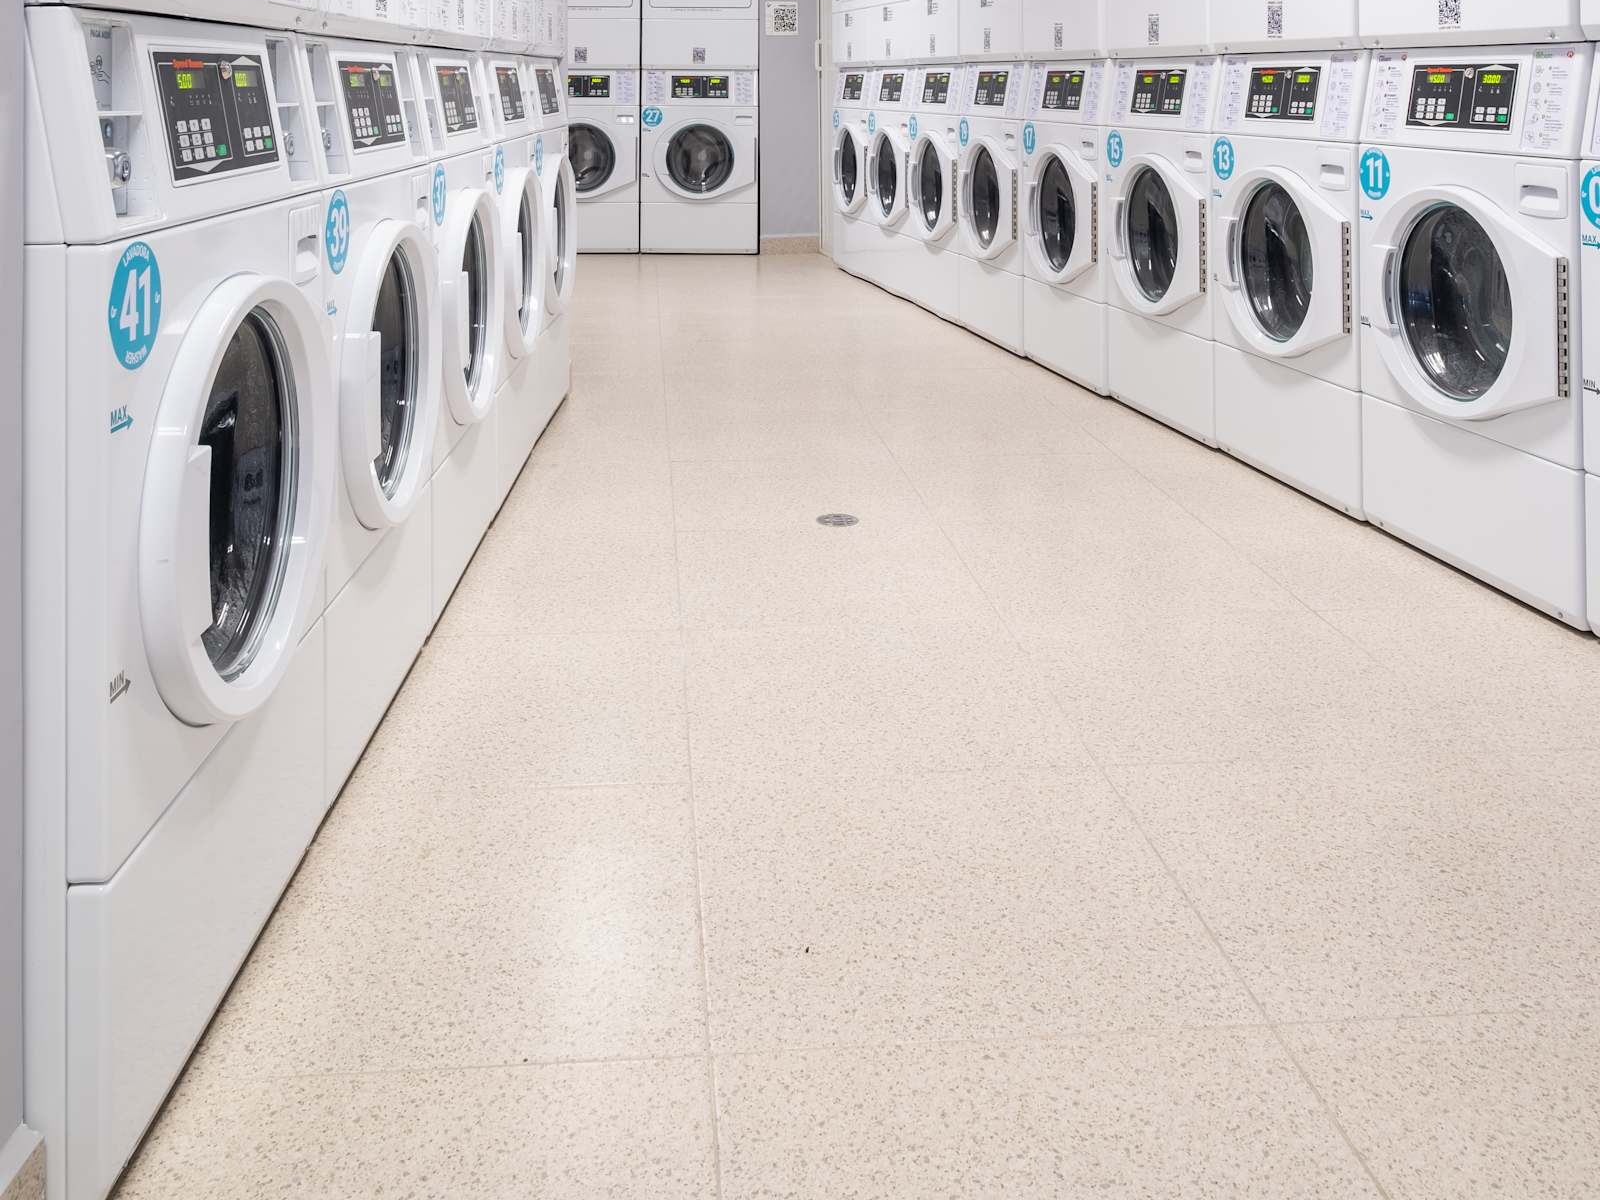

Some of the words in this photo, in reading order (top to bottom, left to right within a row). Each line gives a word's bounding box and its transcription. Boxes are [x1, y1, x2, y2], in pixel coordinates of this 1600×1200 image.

[646, 110, 660, 122] 27
[1025, 127, 1034, 147] 17
[1110, 138, 1120, 160] 15
[1217, 144, 1230, 171] 13
[1366, 157, 1383, 189] 11
[435, 175, 444, 213] 37
[331, 206, 347, 257] 39
[1582, 234, 1597, 243] MAX
[122, 244, 150, 267] LAVADORA
[119, 264, 152, 342] 41
[1583, 378, 1596, 389] MIN
[110, 405, 127, 426] MAX
[109, 670, 125, 698] MIN
